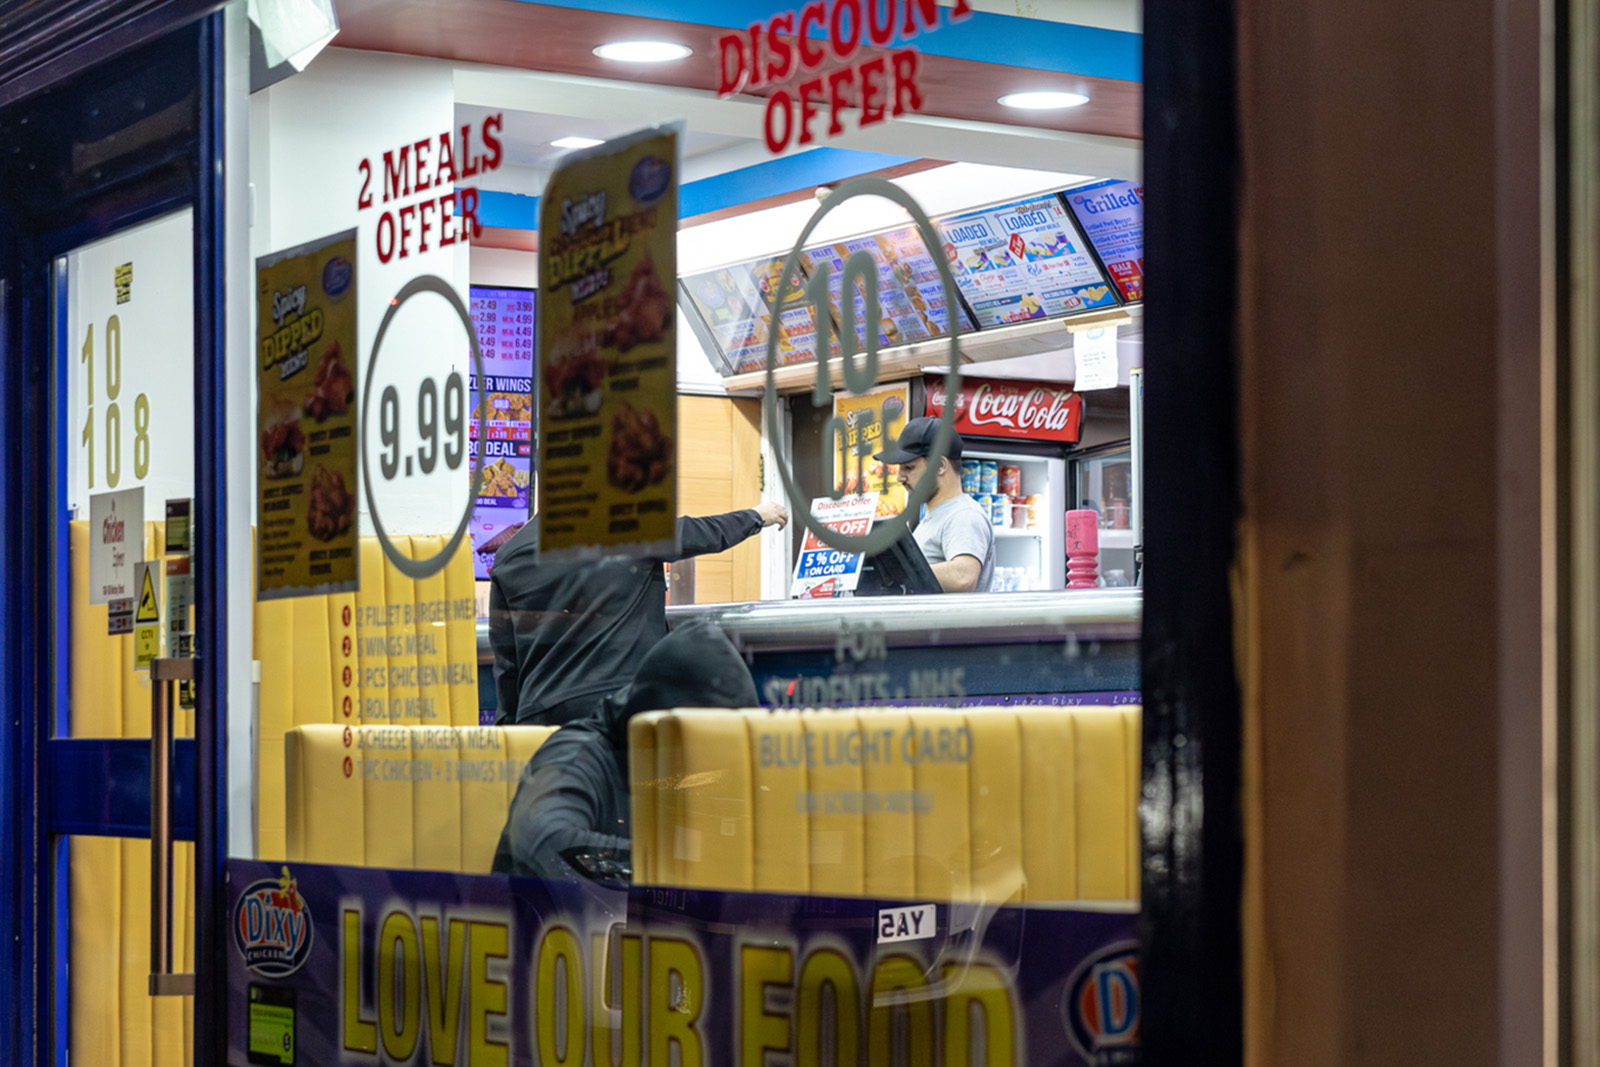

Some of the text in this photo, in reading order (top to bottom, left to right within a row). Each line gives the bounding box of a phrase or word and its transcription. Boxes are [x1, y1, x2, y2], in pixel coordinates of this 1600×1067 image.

[765, 48, 921, 154] OFFER
[358, 112, 503, 211] 2 MEALS
[1083, 188, 1139, 215] Grilled
[376, 187, 484, 264] OFFER
[1004, 211, 1047, 231] LOADED
[946, 224, 988, 244] LOADED
[273, 285, 306, 326] Spicy
[480, 300, 496, 310] 2.49
[516, 302, 532, 312] 3.99
[480, 312, 496, 322] 2.99
[516, 314, 532, 324] 4.99
[806, 249, 879, 407] 10
[262, 309, 323, 369] DIPPED
[480, 324, 496, 334] 2.49
[515, 327, 532, 337] 4.49
[515, 339, 531, 349] 6.49
[82, 314, 121, 406] 10
[515, 351, 531, 361] 6.49
[495, 378, 531, 392] WINGS
[969, 383, 1073, 431] Coca-Cola
[380, 371, 464, 481] 9.99
[486, 441, 517, 456] DEAL
[817, 497, 872, 511] Discount Offer
[840, 520, 867, 535] OFF
[805, 551, 855, 568] 5 % OFF
[810, 564, 846, 576] ON CARD
[366, 604, 402, 627] FILLET
[404, 601, 449, 625] BURGER
[366, 635, 402, 658] WINGS
[405, 634, 437, 656] MEAL
[366, 667, 386, 688] PCS
[389, 665, 439, 688] CHICKEN
[442, 663, 475, 685] MEAL
[405, 697, 437, 719] MEAL
[1051, 697, 1082, 707] Dixy
[365, 729, 408, 750] CHEESE
[468, 727, 502, 750] MEAL
[760, 725, 974, 768] BLUE LIGHT CARD
[247, 889, 304, 958] Dixy
[343, 907, 510, 1067] LOVE
[535, 924, 704, 1067] OUR
[741, 942, 1016, 1067] FOOD
